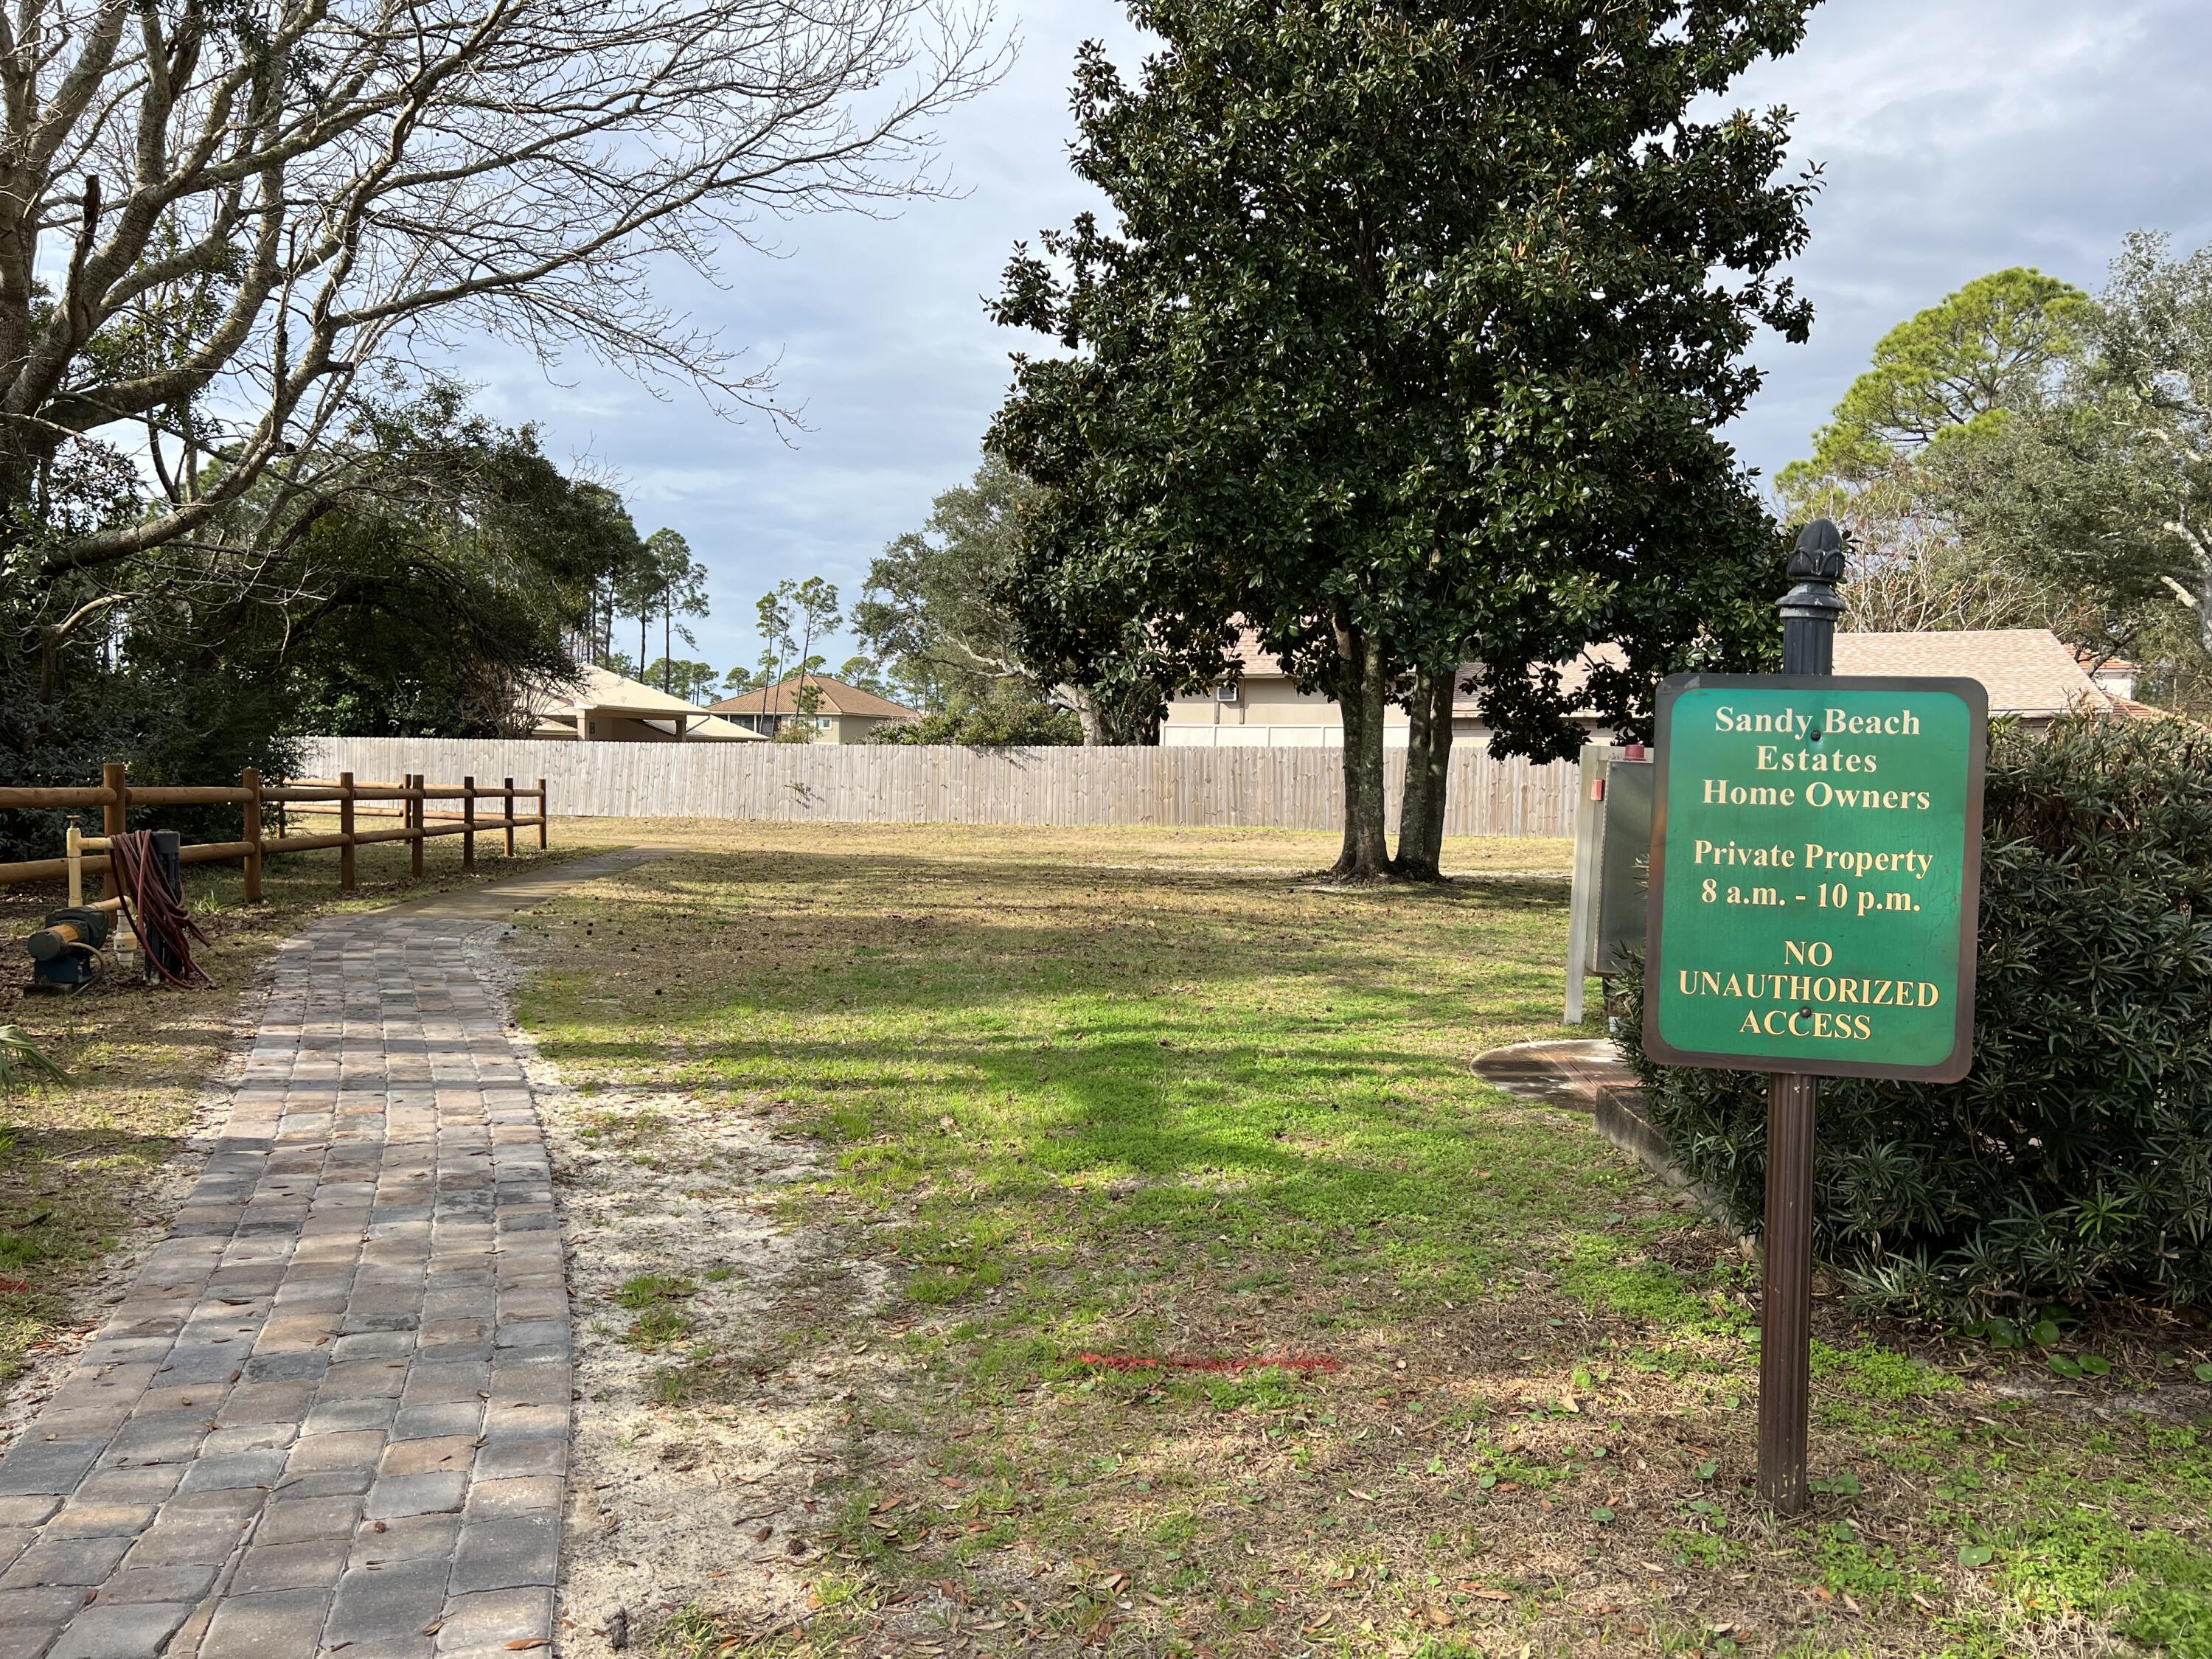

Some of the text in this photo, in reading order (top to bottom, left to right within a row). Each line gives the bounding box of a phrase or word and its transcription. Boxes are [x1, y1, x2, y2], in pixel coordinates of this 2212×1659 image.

[1715, 706, 1921, 740] Sandy Beach
[1756, 745, 1877, 773] Estates
[1702, 779, 1930, 810] Home Owners
[1694, 839, 1934, 880] Private Property
[1701, 878, 1717, 903] 8
[1726, 886, 1786, 906] a.m.
[1818, 883, 1848, 908] 10
[1857, 891, 1921, 917] p.m.
[1784, 940, 1833, 967] NO
[1680, 970, 1939, 1007] UNAUTHORIZED
[1739, 1009, 1871, 1040] ACCESS
